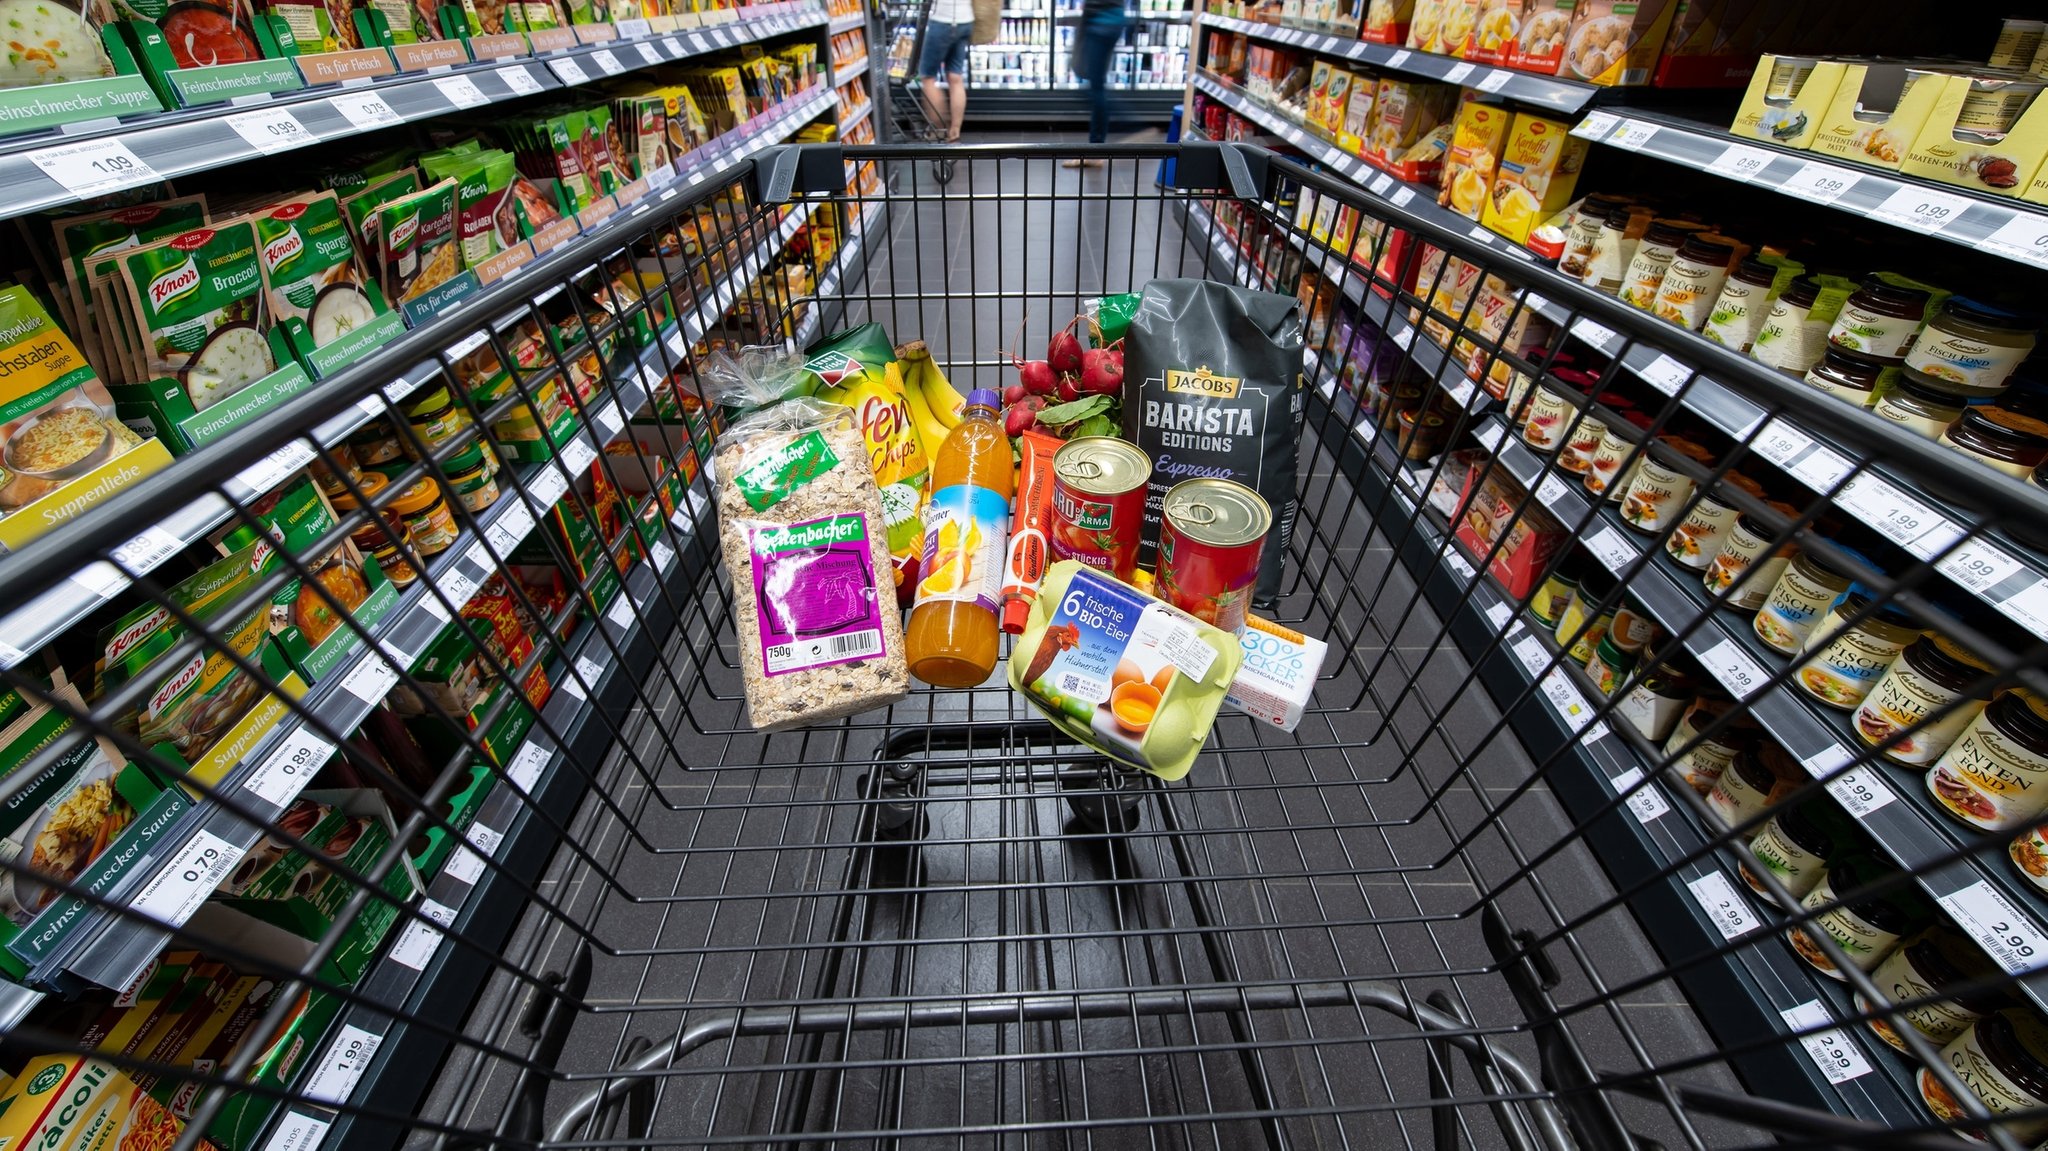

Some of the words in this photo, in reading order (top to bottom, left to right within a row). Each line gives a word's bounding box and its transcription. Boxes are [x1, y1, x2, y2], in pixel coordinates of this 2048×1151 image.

[317, 61, 333, 76] Fix
[333, 60, 349, 76] für
[351, 56, 381, 73] Fleisch
[408, 49, 422, 64] Fix
[422, 48, 435, 64] für
[435, 46, 458, 61] Fleisch
[182, 72, 261, 95] Feinschmecker
[264, 69, 294, 86] Suppe
[0, 94, 103, 121] einschmecker
[106, 88, 150, 106] Suppe
[361, 103, 385, 115] 0.79
[267, 121, 297, 136] 0.99
[1463, 119, 1493, 142] Kartoffel
[1514, 132, 1551, 155] Kartoffel
[1827, 142, 1848, 153] PASTE
[92, 155, 133, 174] 1.09
[1735, 157, 1761, 170] 0.99
[1908, 153, 1970, 173] BRATEN-PASTE
[459, 183, 488, 200] Knorr
[1814, 176, 1844, 191] 0.99
[1914, 203, 1950, 219] 0.99
[391, 218, 418, 242] Knorr
[264, 236, 301, 264] Knorr
[150, 268, 198, 303] Knorr
[212, 261, 258, 292] Broccoli
[1664, 274, 1708, 297] EFLÜGEL
[441, 280, 469, 303] Gemüse
[1662, 285, 1689, 301] FOND
[1859, 323, 1885, 337] FOND
[317, 329, 376, 371] Feinschmecker
[375, 318, 400, 339] Suppe
[1929, 344, 1957, 361] FISCH
[1959, 354, 1990, 367] FOND
[45, 352, 72, 371] Suppe
[1173, 374, 1233, 395] JACOBS
[6, 404, 20, 416] mit
[20, 394, 44, 410] vielen
[194, 390, 273, 440] Feinschmecker
[273, 373, 304, 397] Suppe
[861, 395, 912, 444] fen
[1145, 400, 1254, 437] BARISTA
[871, 436, 916, 474] Chips
[1161, 433, 1232, 453] EDITIONS
[1768, 434, 1794, 453] 1.99
[1154, 454, 1234, 480] Espresso
[42, 463, 141, 526] Suppenliebe
[1075, 512, 1109, 527] PARMA
[1144, 514, 1160, 524] FLAT
[1887, 506, 1919, 531] 1.99
[493, 530, 510, 549] 1.79
[813, 558, 857, 573] Mischung
[1071, 550, 1107, 566] STÜCKIG
[1609, 549, 1628, 566] 2.99
[1957, 551, 1995, 577] 1.99
[449, 575, 469, 595] 1.79
[370, 589, 395, 617] Suppe
[1063, 590, 1086, 617] 6
[1085, 594, 1125, 623] frische
[1772, 595, 1803, 621] FOND
[1775, 582, 1818, 617] FISCH
[109, 607, 168, 658] Knorr
[1078, 610, 1130, 644] BIO-Eier
[767, 645, 792, 659] 750g
[1080, 650, 1108, 665] mobilen
[1101, 643, 1118, 656] dem
[1241, 630, 1306, 671] 30%
[1827, 639, 1889, 673] FISCH
[1064, 654, 1109, 676] Hühnerstall
[1726, 664, 1752, 687] 2.99
[1827, 655, 1871, 679] FOND
[1553, 684, 1571, 702] 0.59
[214, 700, 283, 769] Suppenliebe
[504, 716, 524, 745] Soße
[70, 740, 94, 766] Sauce
[282, 747, 312, 776] 0.89
[527, 746, 543, 766] 1.29
[1974, 727, 2048, 773] Lacroix
[1958, 755, 2006, 792] FOND
[1960, 735, 2034, 792] ENTEN
[1842, 775, 1874, 802] 2.99
[1635, 790, 1656, 812] 2.99
[141, 800, 182, 842] Sauce
[145, 863, 178, 899] CHAMPIGNON
[175, 850, 191, 867] RAHM
[189, 835, 205, 852] SAUCE
[182, 847, 220, 883] 0.79
[1718, 900, 1743, 927] 2.99
[1980, 882, 1993, 897] LAC
[1991, 894, 2024, 929] KALBS-FOND
[2020, 921, 2041, 940] 400ML
[1991, 921, 2035, 957] 2.99
[279, 1037, 303, 1077] Knorr
[337, 1039, 363, 1072] 1.99
[1820, 1036, 1851, 1069] 2.99
